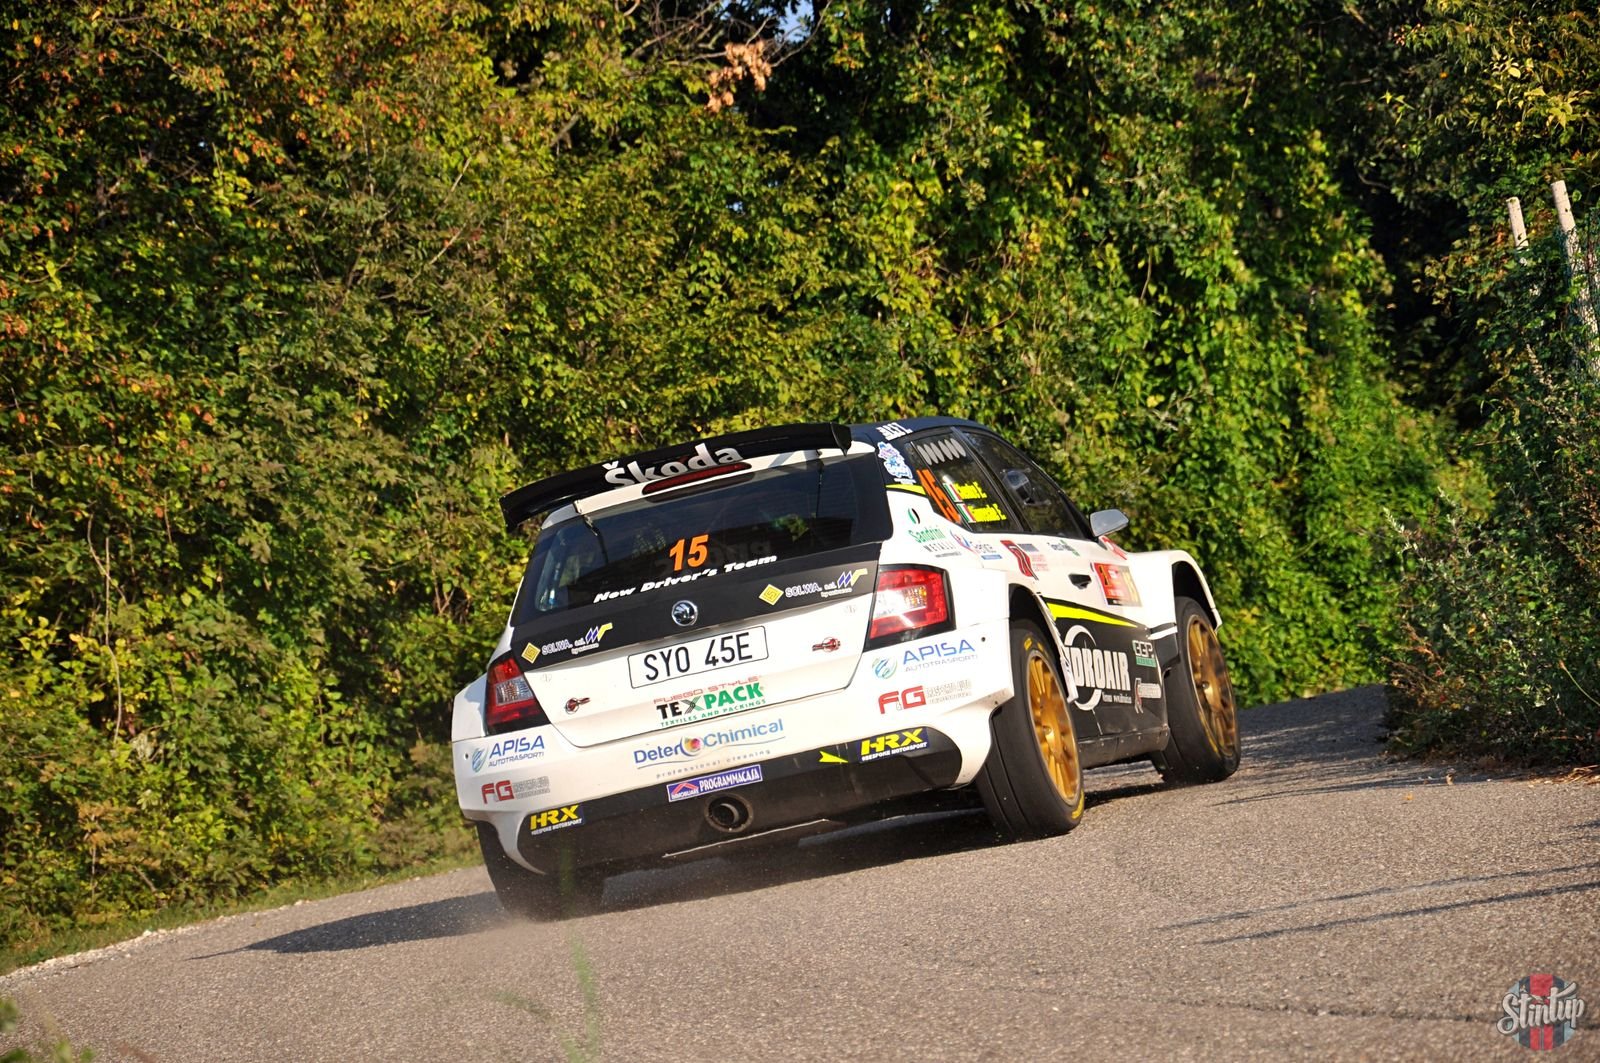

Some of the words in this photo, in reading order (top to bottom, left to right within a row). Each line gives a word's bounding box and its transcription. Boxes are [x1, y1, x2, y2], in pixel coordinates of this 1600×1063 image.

[669, 534, 709, 571] 15
[593, 587, 636, 603] New
[640, 568, 718, 592] Driver's
[724, 555, 777, 573] Team
[704, 632, 753, 667] 45E
[903, 639, 975, 665] APISA
[708, 676, 759, 692] STYLE
[661, 715, 697, 727] TEXTILES
[701, 710, 719, 718] AND
[723, 699, 766, 713] PACKINGS
[878, 685, 927, 714] FG
[489, 735, 545, 759] APISA
[861, 728, 923, 756] HRX
[488, 752, 544, 767] AUTOTRASPORTI
[656, 760, 721, 779] professional
[726, 750, 771, 763] cleaning
[481, 780, 515, 804] FG
[699, 769, 760, 792] PROGRAMMACASA
[530, 805, 580, 830] HRX
